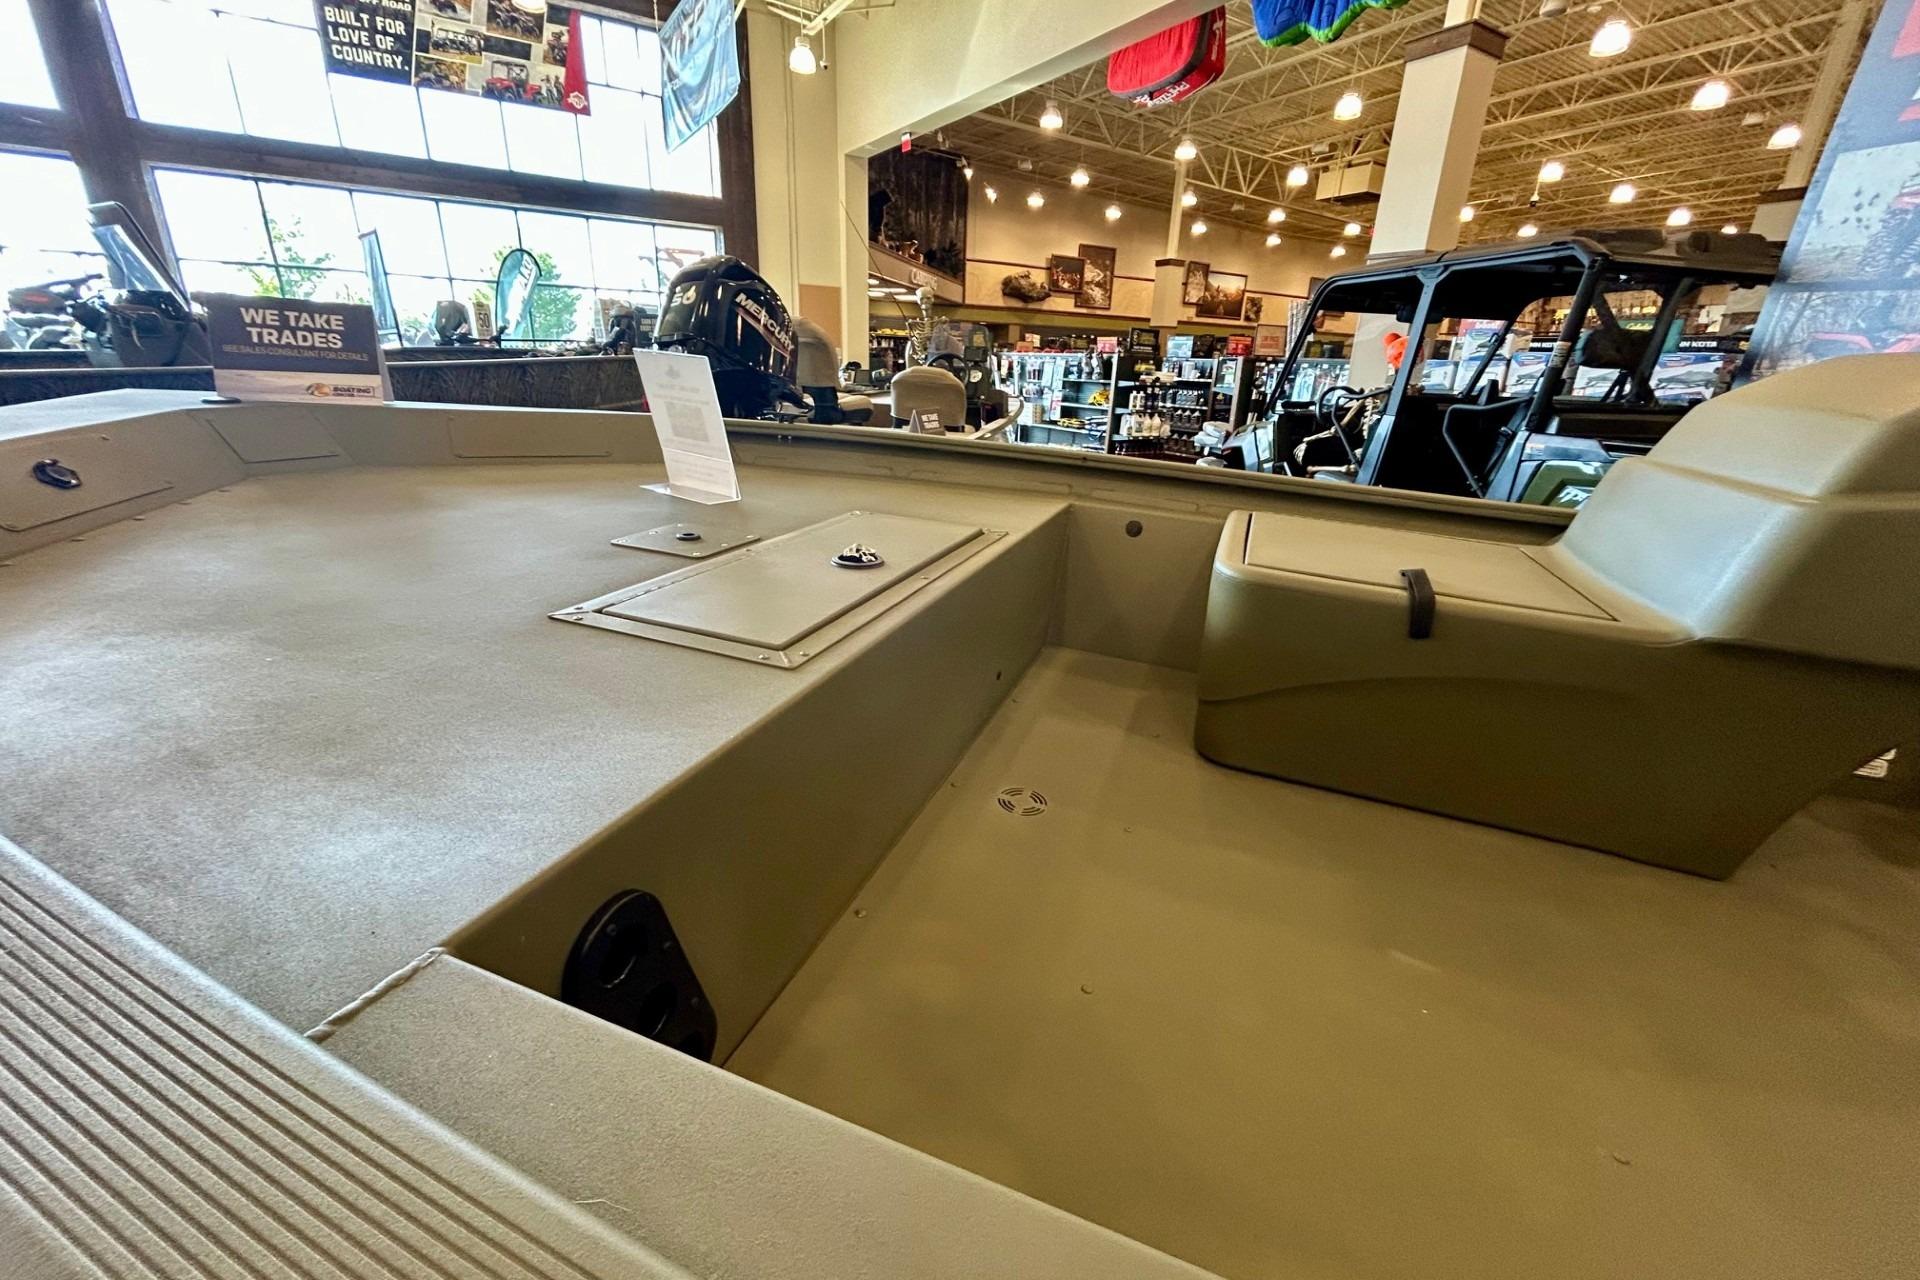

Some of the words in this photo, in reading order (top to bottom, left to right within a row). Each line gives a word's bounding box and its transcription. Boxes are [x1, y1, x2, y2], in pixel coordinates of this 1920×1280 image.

[324, 6, 370, 28] BUILT
[375, 16, 406, 36] FOR
[328, 25, 370, 46] LOVE
[375, 34, 394, 50] OF
[331, 44, 409, 71] COUNTRY.
[240, 307, 280, 326] WE
[284, 311, 345, 330] TAKE
[735, 292, 795, 352] MERCURY
[246, 326, 343, 349] TRADES
